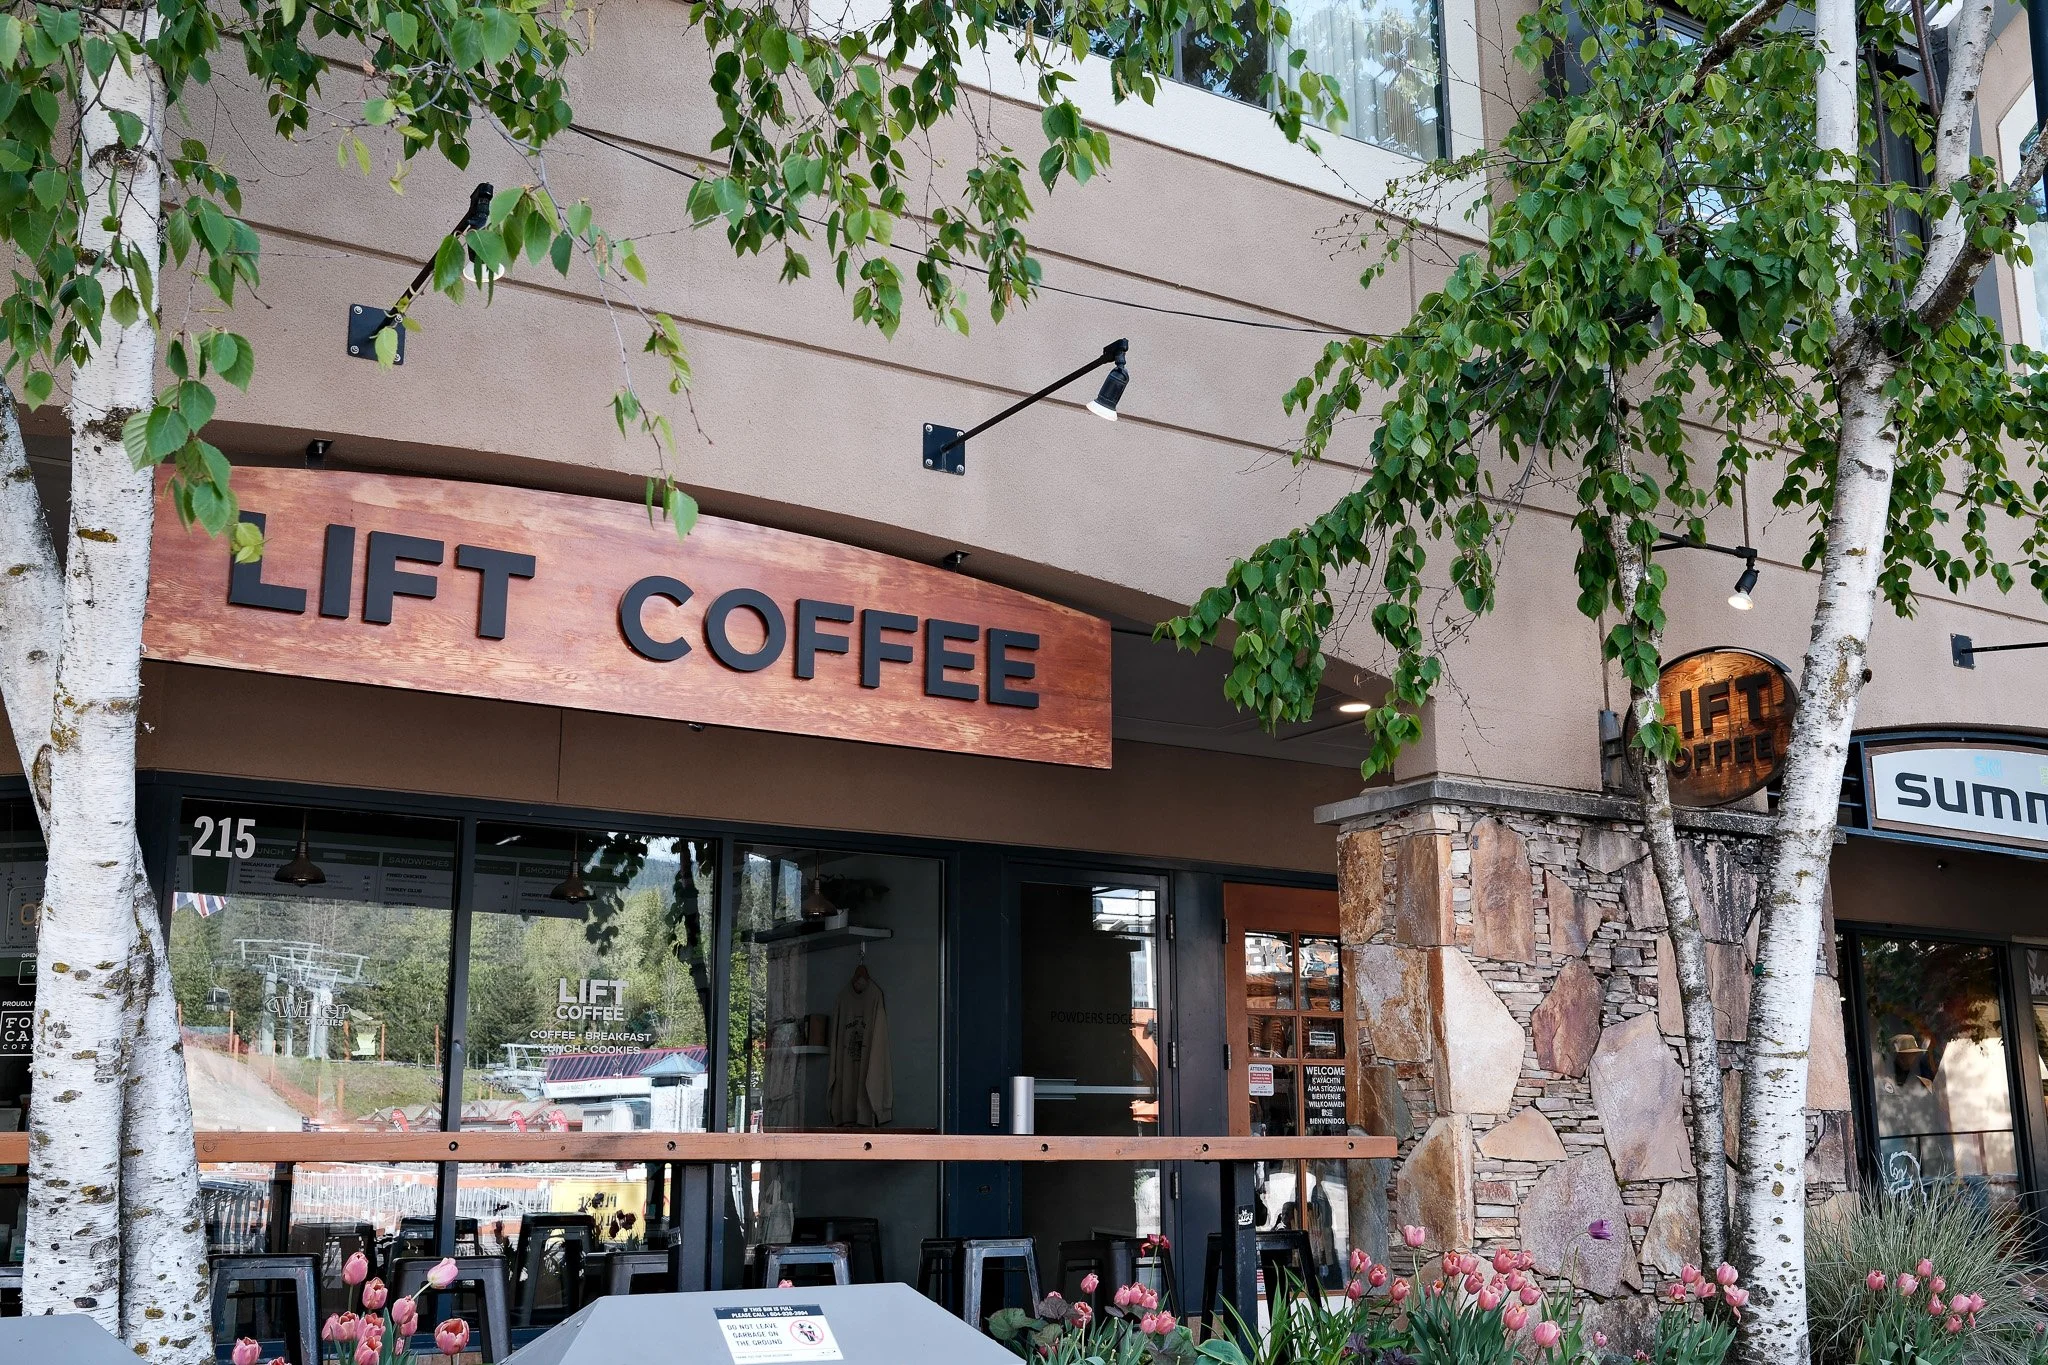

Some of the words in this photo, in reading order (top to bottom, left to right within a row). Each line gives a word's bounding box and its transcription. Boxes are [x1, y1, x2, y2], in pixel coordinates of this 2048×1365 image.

[227, 509, 536, 640] LIFT
[618, 574, 1042, 709] COFFEE
[1664, 671, 1771, 740] IFT
[1669, 731, 1774, 776] OFFEE
[190, 815, 256, 859] 215
[255, 847, 284, 856] UNCH
[388, 856, 450, 868] SANDWICHES
[525, 866, 569, 876] SMOOTHIE
[558, 977, 629, 1005] LIFT
[1, 1000, 34, 1008] PROUDLY
[556, 1004, 625, 1021] COFFEE
[1050, 1010, 1104, 1025] POWDERS
[5, 1017, 31, 1029] FO
[4, 1030, 30, 1042] CA
[529, 1030, 576, 1040] COFFEE
[585, 1031, 652, 1042] BREAKFAST
[590, 1045, 641, 1055] COOKIES
[1305, 1066, 1346, 1076] WELCOME
[1308, 1100, 1345, 1108] WILLKOMMEN
[1309, 1117, 1346, 1125] BIENVENIDOS
[755, 1322, 779, 1330] LEAVE
[732, 1331, 767, 1339] GARBAGE
[752, 1338, 783, 1346] GROUND
